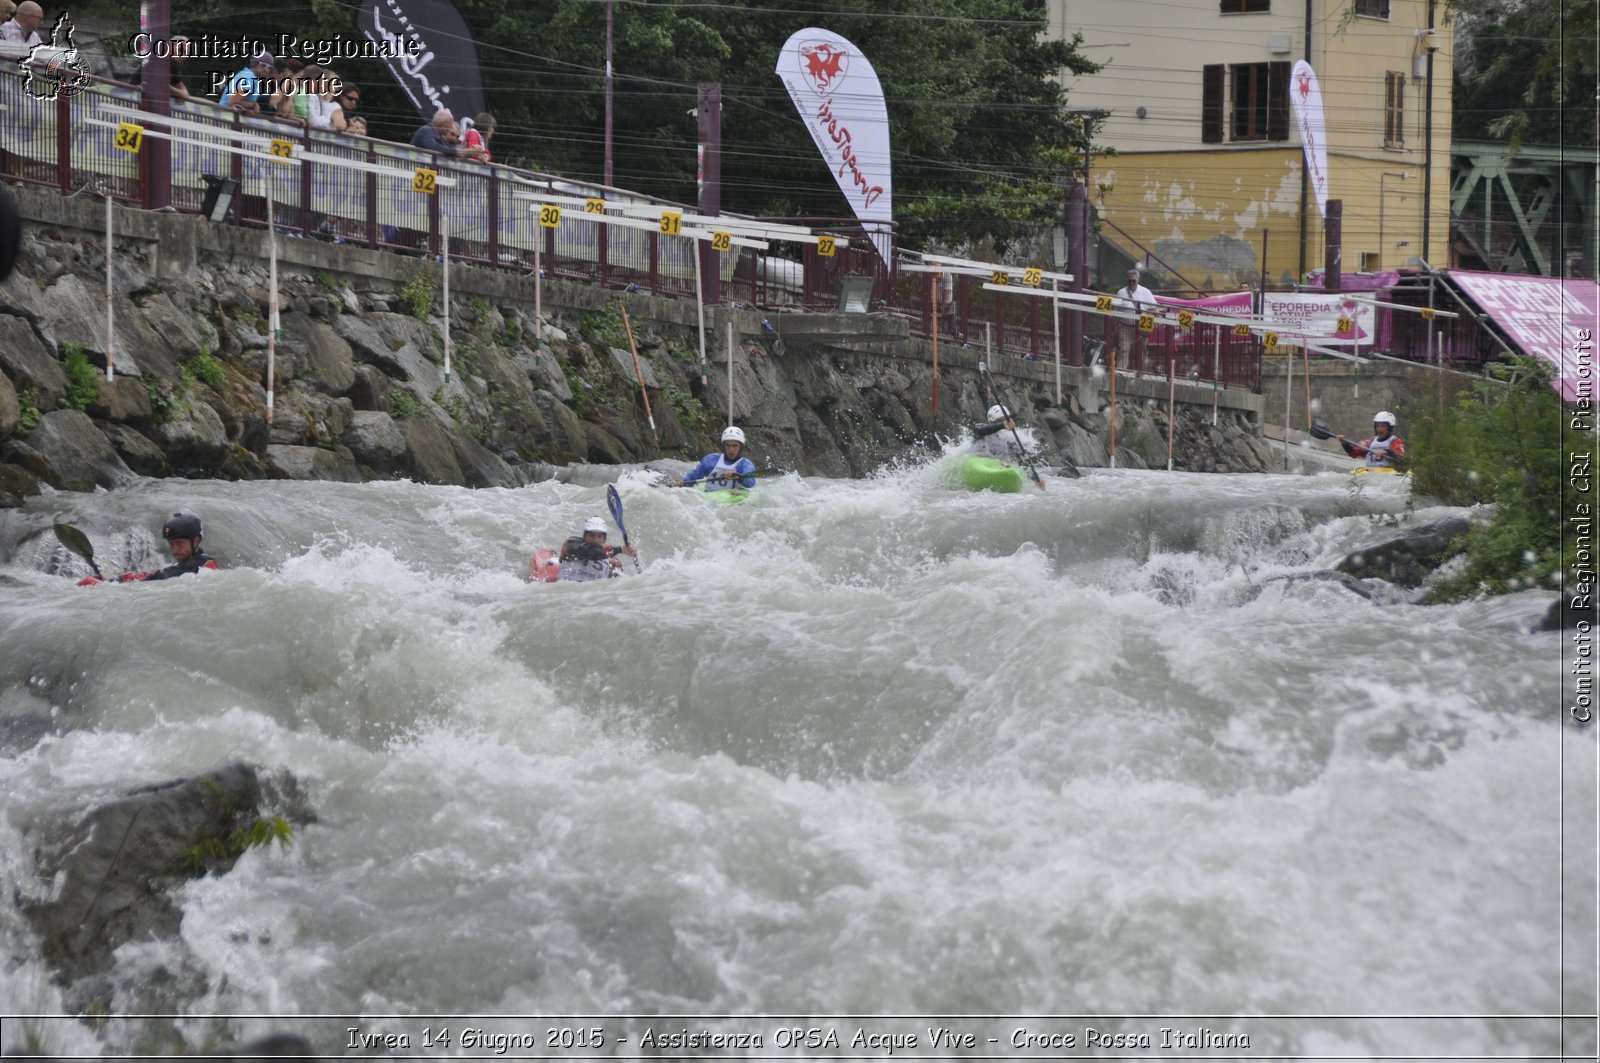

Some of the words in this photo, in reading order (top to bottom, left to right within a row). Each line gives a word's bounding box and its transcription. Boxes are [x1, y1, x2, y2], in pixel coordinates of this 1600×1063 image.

[117, 129, 139, 149] 34
[414, 171, 434, 191] 32
[541, 207, 559, 224] 30
[660, 215, 679, 233] 31
[712, 233, 730, 249] 28
[819, 239, 834, 254] 27
[993, 271, 1008, 284] 25
[1025, 270, 1041, 284] 26
[1458, 275, 1595, 316] EPOREDIA
[1097, 297, 1111, 311] 24
[1139, 315, 1153, 329] 23
[1178, 313, 1192, 327] 22
[1338, 318, 1350, 332] 21
[1265, 333, 1278, 347] 19
